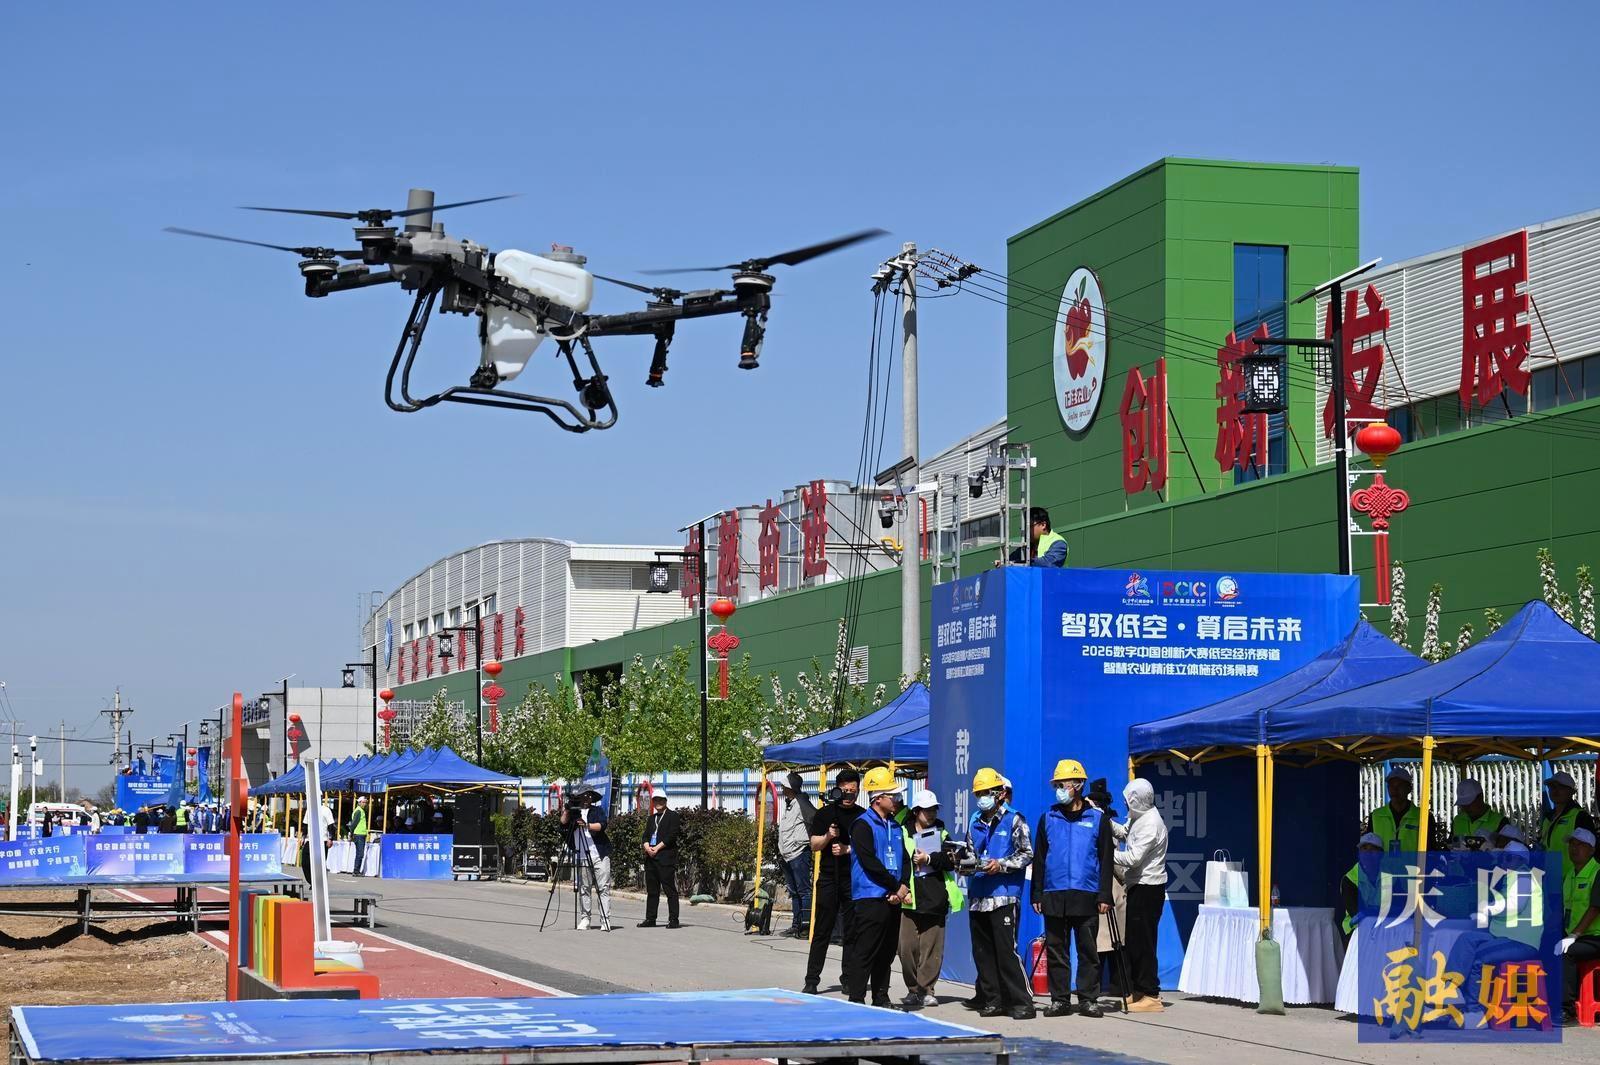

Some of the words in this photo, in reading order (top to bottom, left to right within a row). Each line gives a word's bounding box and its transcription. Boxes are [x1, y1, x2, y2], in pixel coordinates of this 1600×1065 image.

[1119, 229, 1532, 494] 创新发展
[1061, 612, 1302, 642] 智驭低空·算启未来
[1082, 645, 1281, 661] 2026数字中国创新大赛低空经济赛道
[1103, 662, 1259, 677] 智慧农业精准立体施药场景赛
